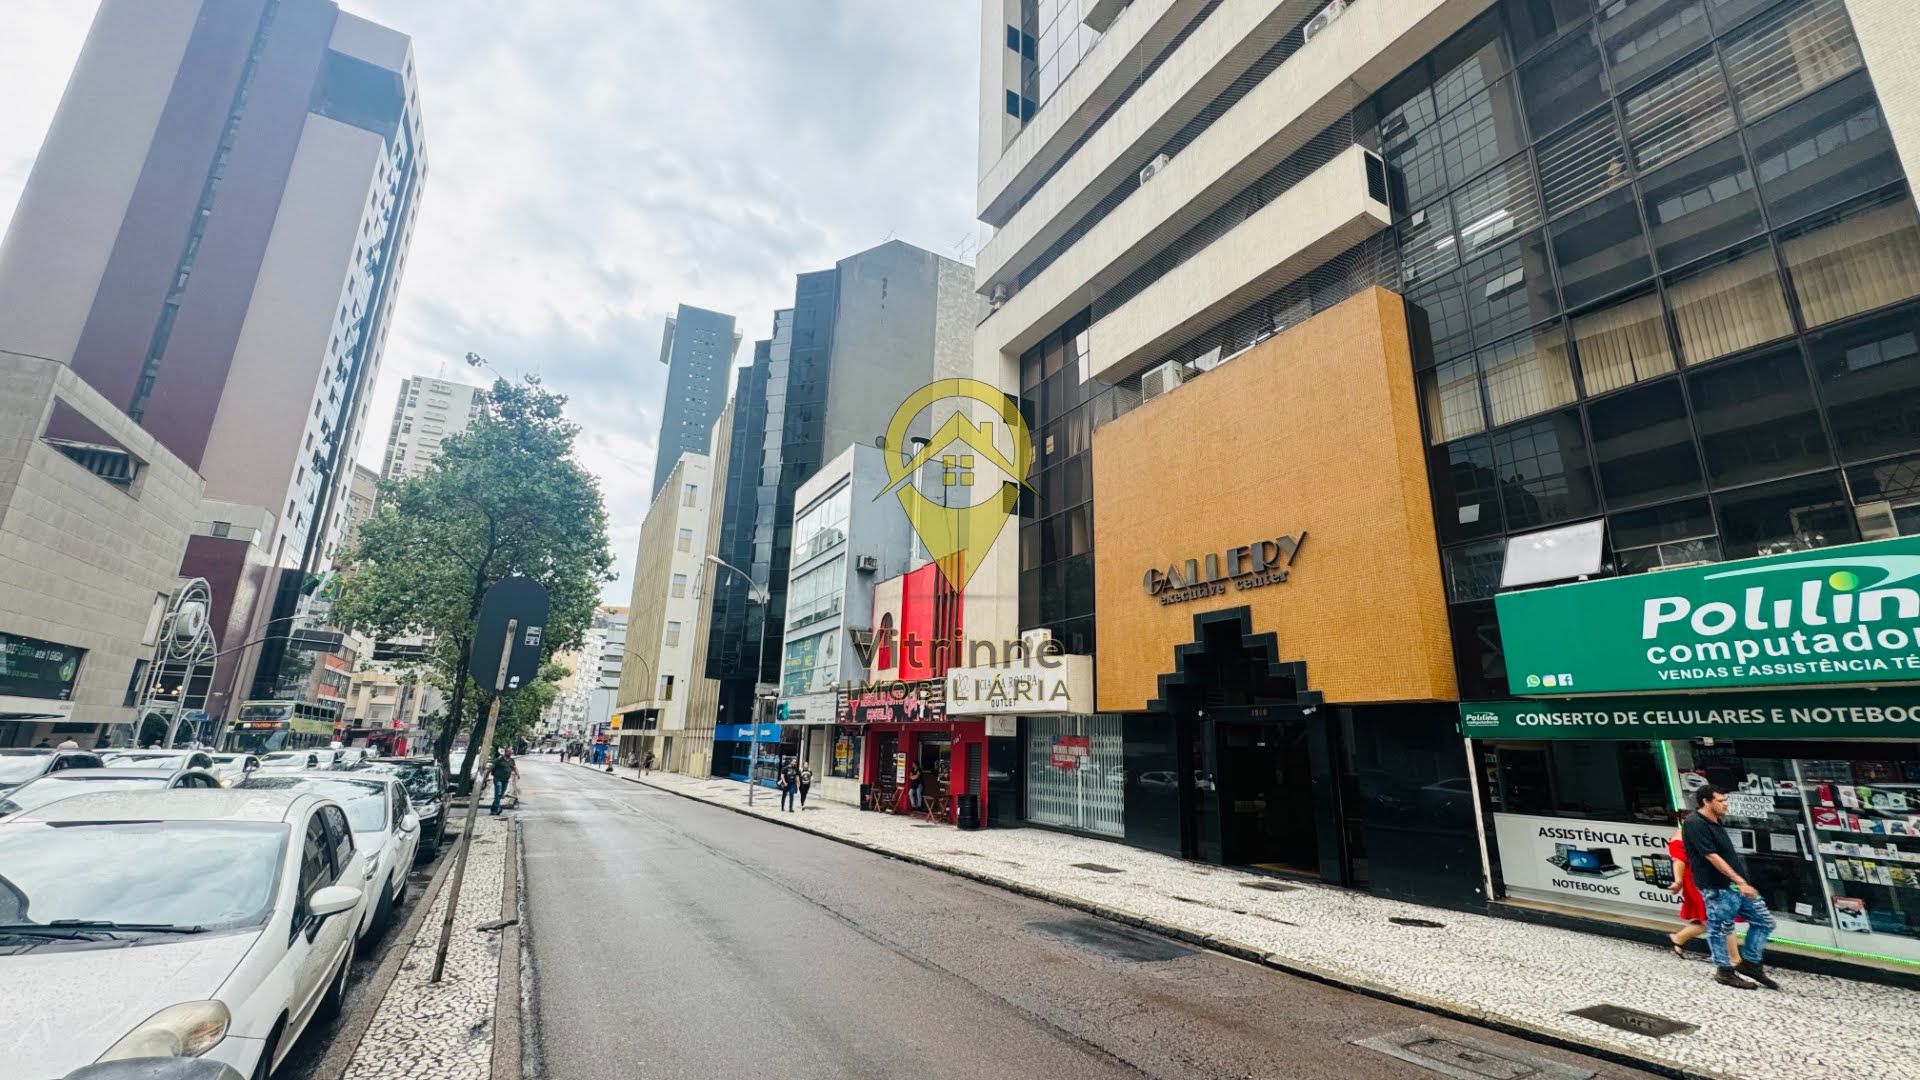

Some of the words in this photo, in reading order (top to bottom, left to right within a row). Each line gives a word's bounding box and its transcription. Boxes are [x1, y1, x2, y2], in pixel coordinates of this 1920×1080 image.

[1143, 531, 1307, 595] GALLERY
[1159, 580, 1225, 606] executive
[1235, 570, 1289, 591] center
[1658, 667, 1729, 681] VENDAS
[1733, 666, 1745, 677] E
[1749, 658, 1884, 676] ASSISTÊNCIA
[991, 698, 1016, 708] OUTLET
[1515, 711, 1609, 726] CONSERTO
[1613, 711, 1640, 725] DE
[1643, 708, 1766, 725] CELULARES
[1771, 708, 1786, 724] E
[1730, 802, 1772, 811] TEBOOKS
[1538, 827, 1630, 845] ASSISTÊNCIA
[1552, 878, 1620, 896] NOTEBOOKS
